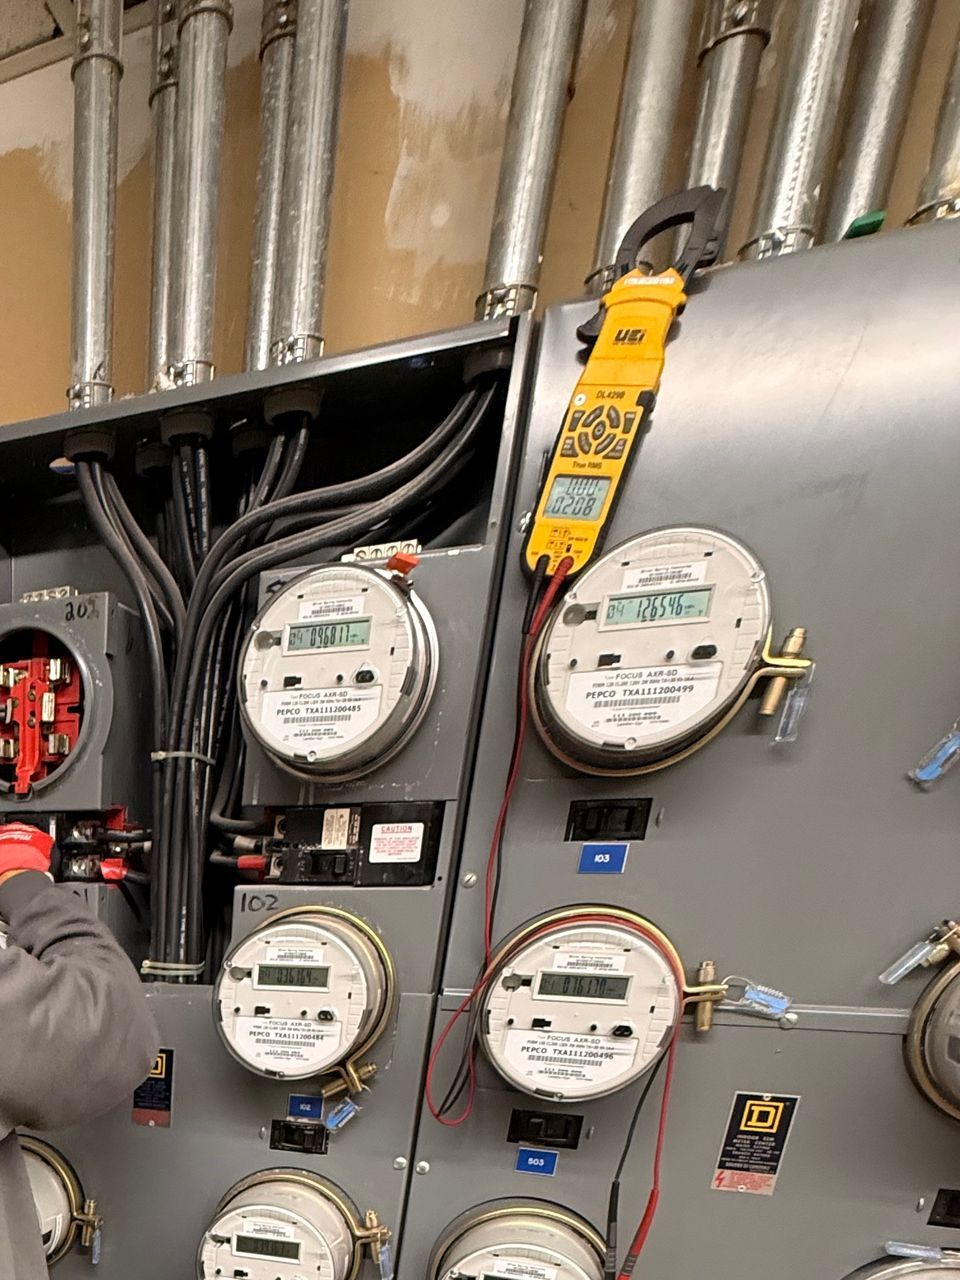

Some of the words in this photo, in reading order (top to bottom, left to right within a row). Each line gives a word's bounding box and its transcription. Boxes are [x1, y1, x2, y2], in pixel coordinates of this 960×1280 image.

[551, 496, 597, 516] 0208
[585, 690, 616, 699] PEPCO
[623, 684, 694, 697] TXA111200499
[277, 708, 301, 716] PEPCO
[594, 854, 610, 863] 103
[240, 892, 279, 912] 102
[521, 1046, 547, 1054] PEPCO
